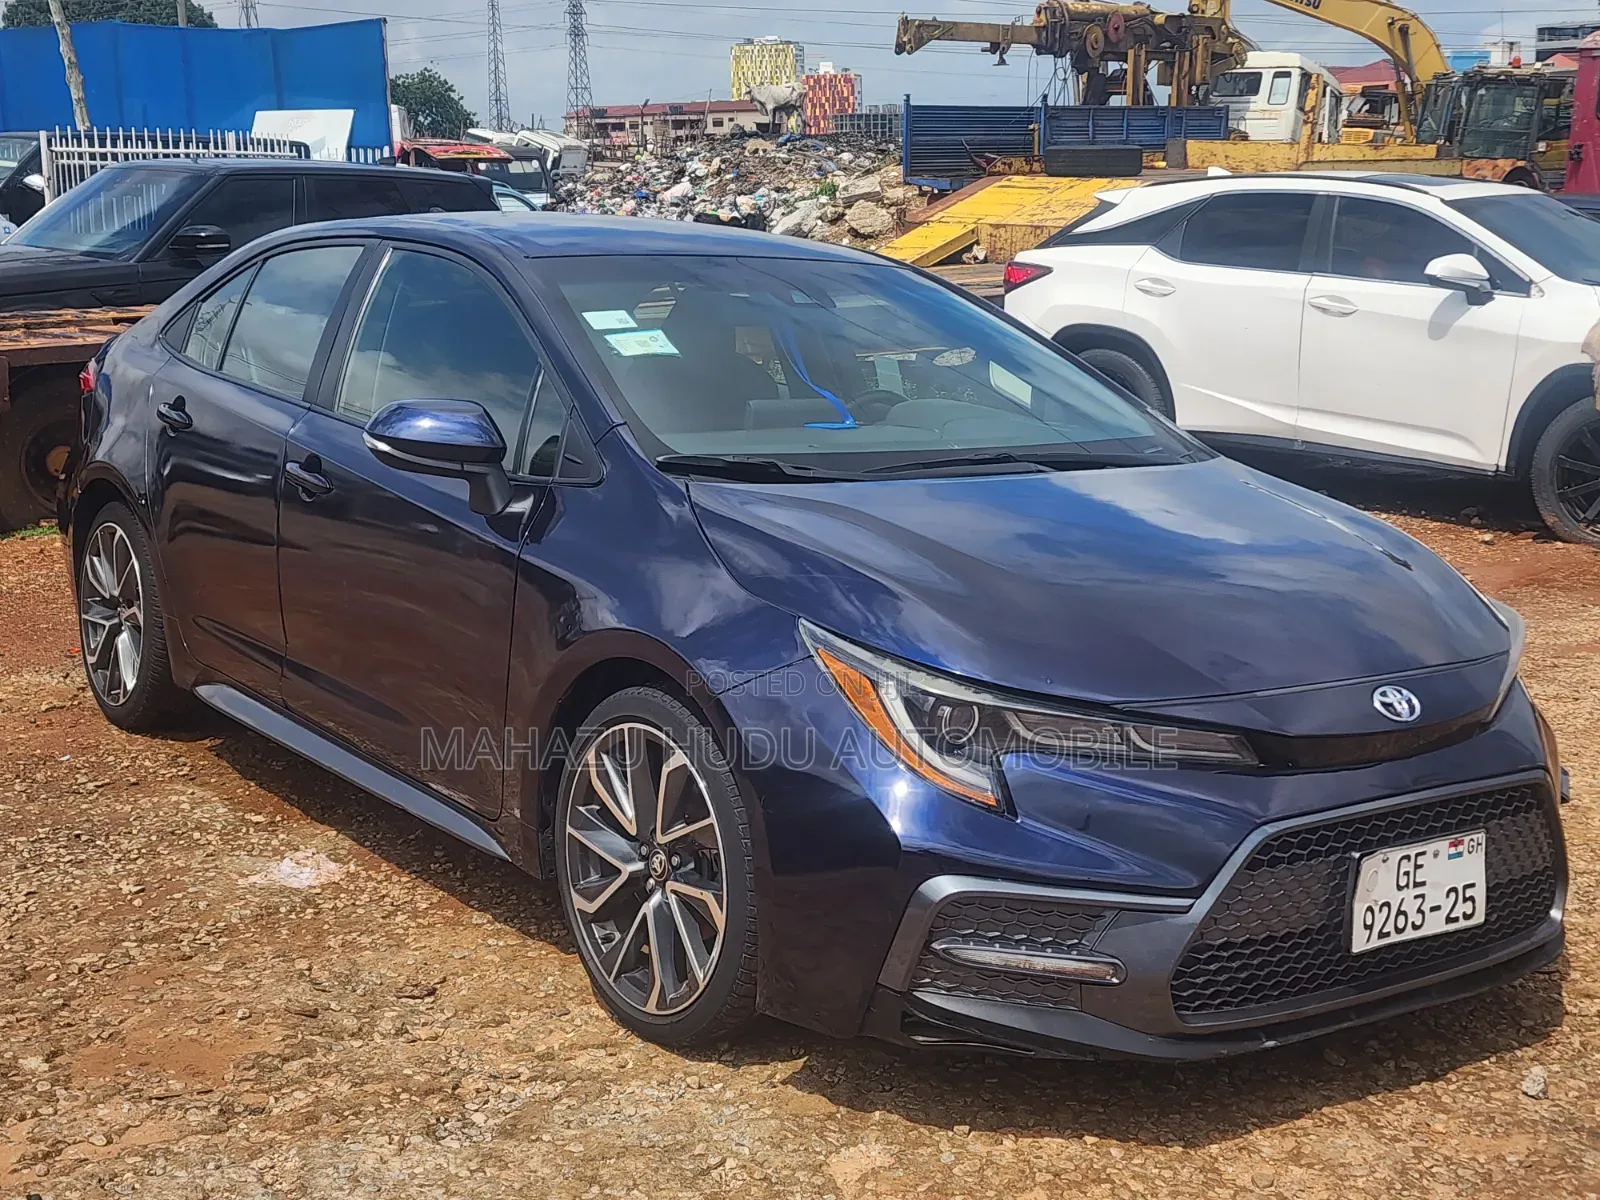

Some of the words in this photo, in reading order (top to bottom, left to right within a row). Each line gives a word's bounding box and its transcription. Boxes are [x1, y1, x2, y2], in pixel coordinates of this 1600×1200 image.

[1467, 835, 1484, 855] GH
[1395, 850, 1428, 892] GE
[1362, 882, 1477, 944] 9263-25
